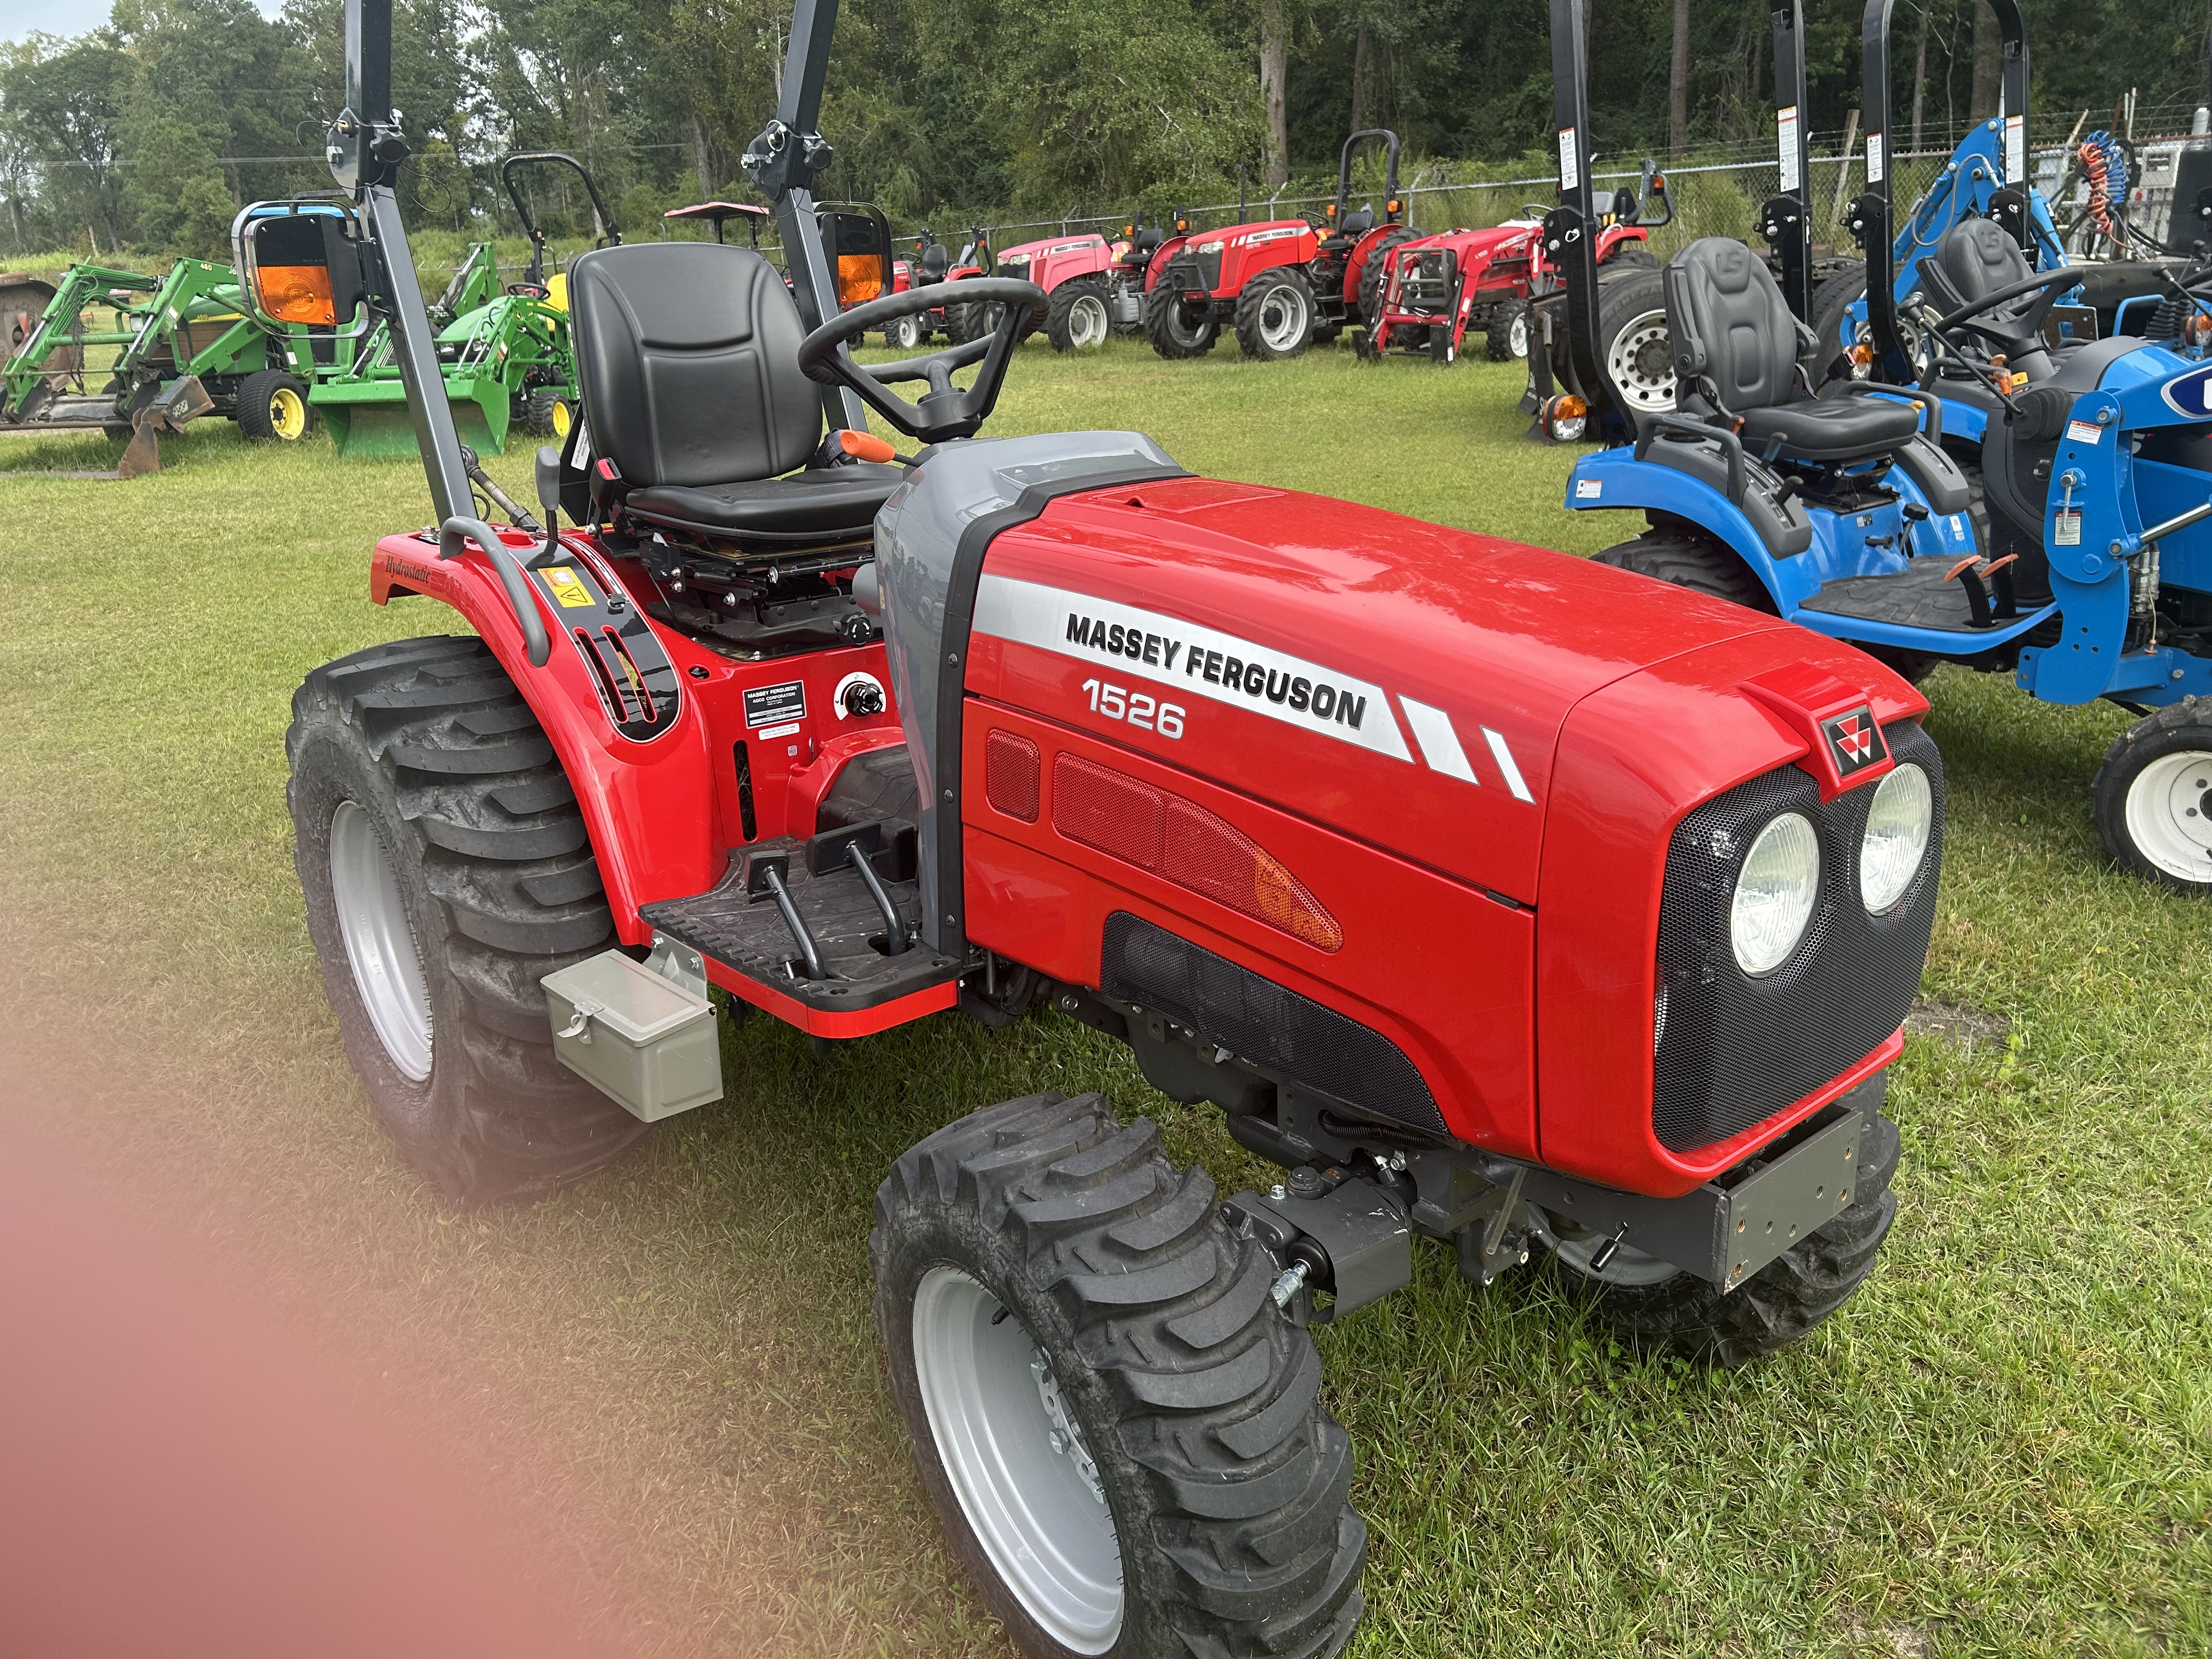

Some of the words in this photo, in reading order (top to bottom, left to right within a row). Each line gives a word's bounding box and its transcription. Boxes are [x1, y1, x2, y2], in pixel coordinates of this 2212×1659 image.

[200, 263, 212, 271] 460
[386, 555, 431, 584] Hydrostatic
[1065, 613, 1182, 669] MASSEY
[1185, 645, 1366, 730] FERGUSON
[747, 690, 769, 699] MASSEY
[766, 692, 796, 701] CORPORATION
[1081, 678, 1187, 740] 1526
